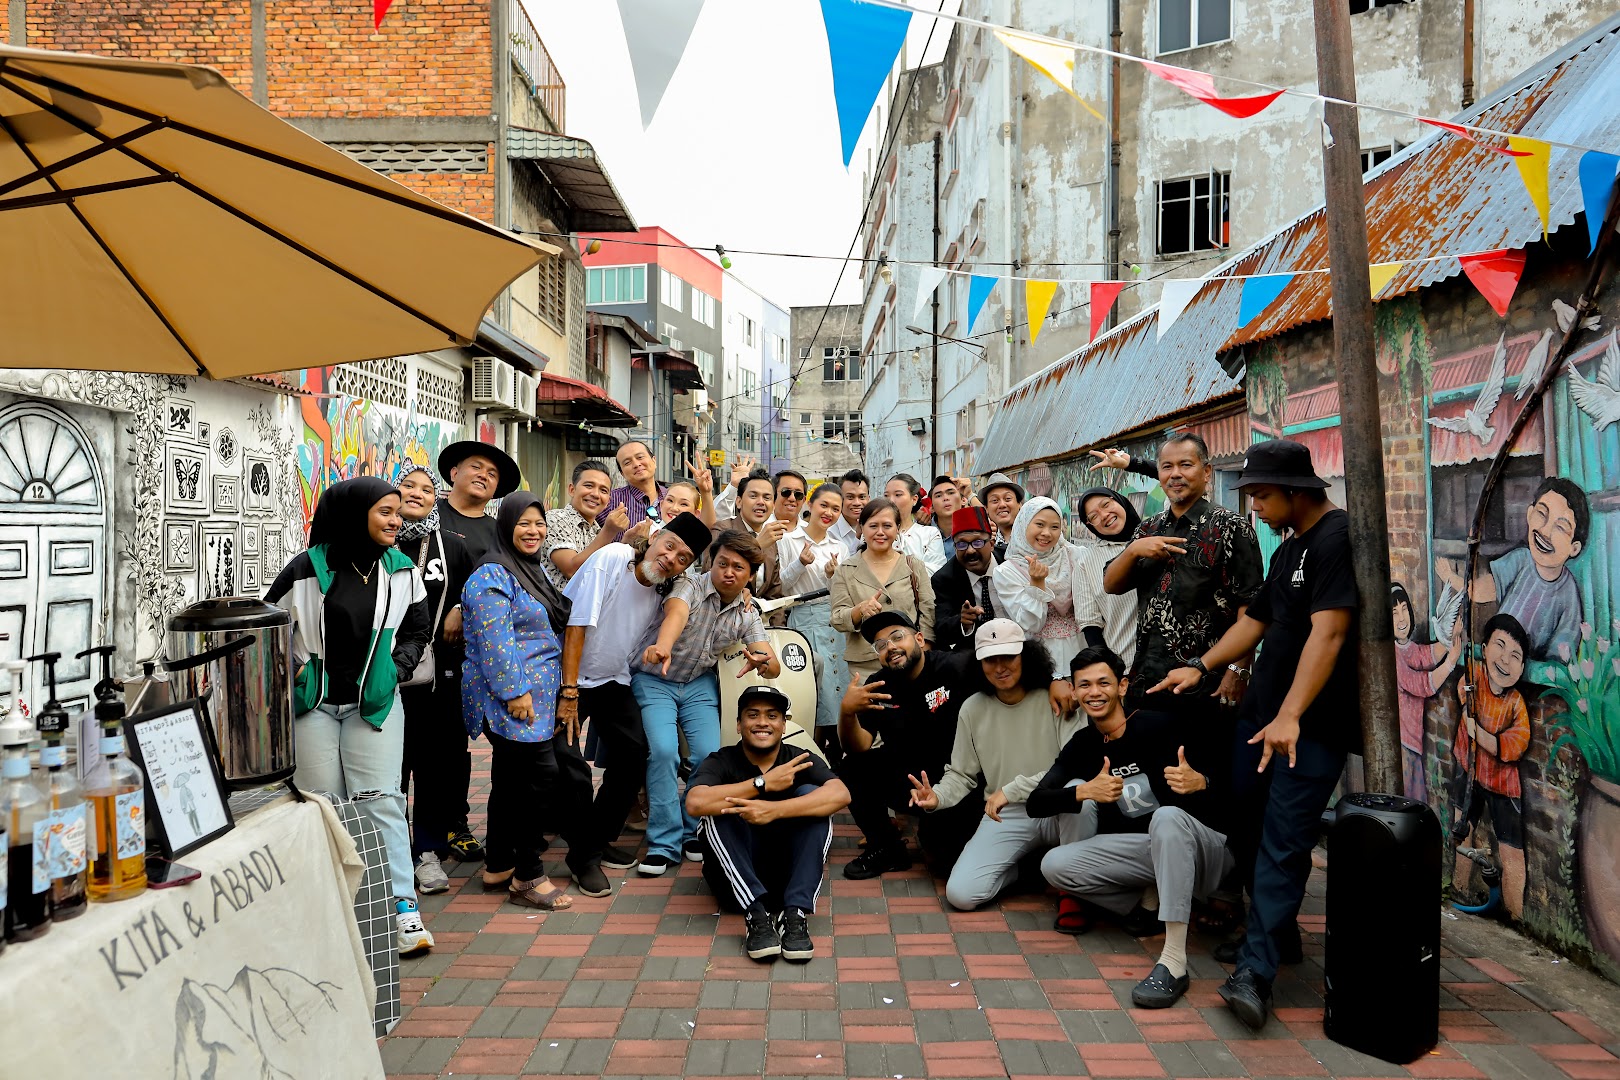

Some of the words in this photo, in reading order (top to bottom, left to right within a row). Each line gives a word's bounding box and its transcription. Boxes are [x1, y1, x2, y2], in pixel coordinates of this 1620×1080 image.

[32, 485, 45, 499] 12
[219, 485, 233, 494] TAM
[219, 495, 232, 504] PIN
[1111, 762, 1140, 778] EOS
[1122, 782, 1153, 813] R
[98, 910, 183, 991] KITA
[183, 901, 206, 938] &
[210, 844, 286, 924] ABADI
